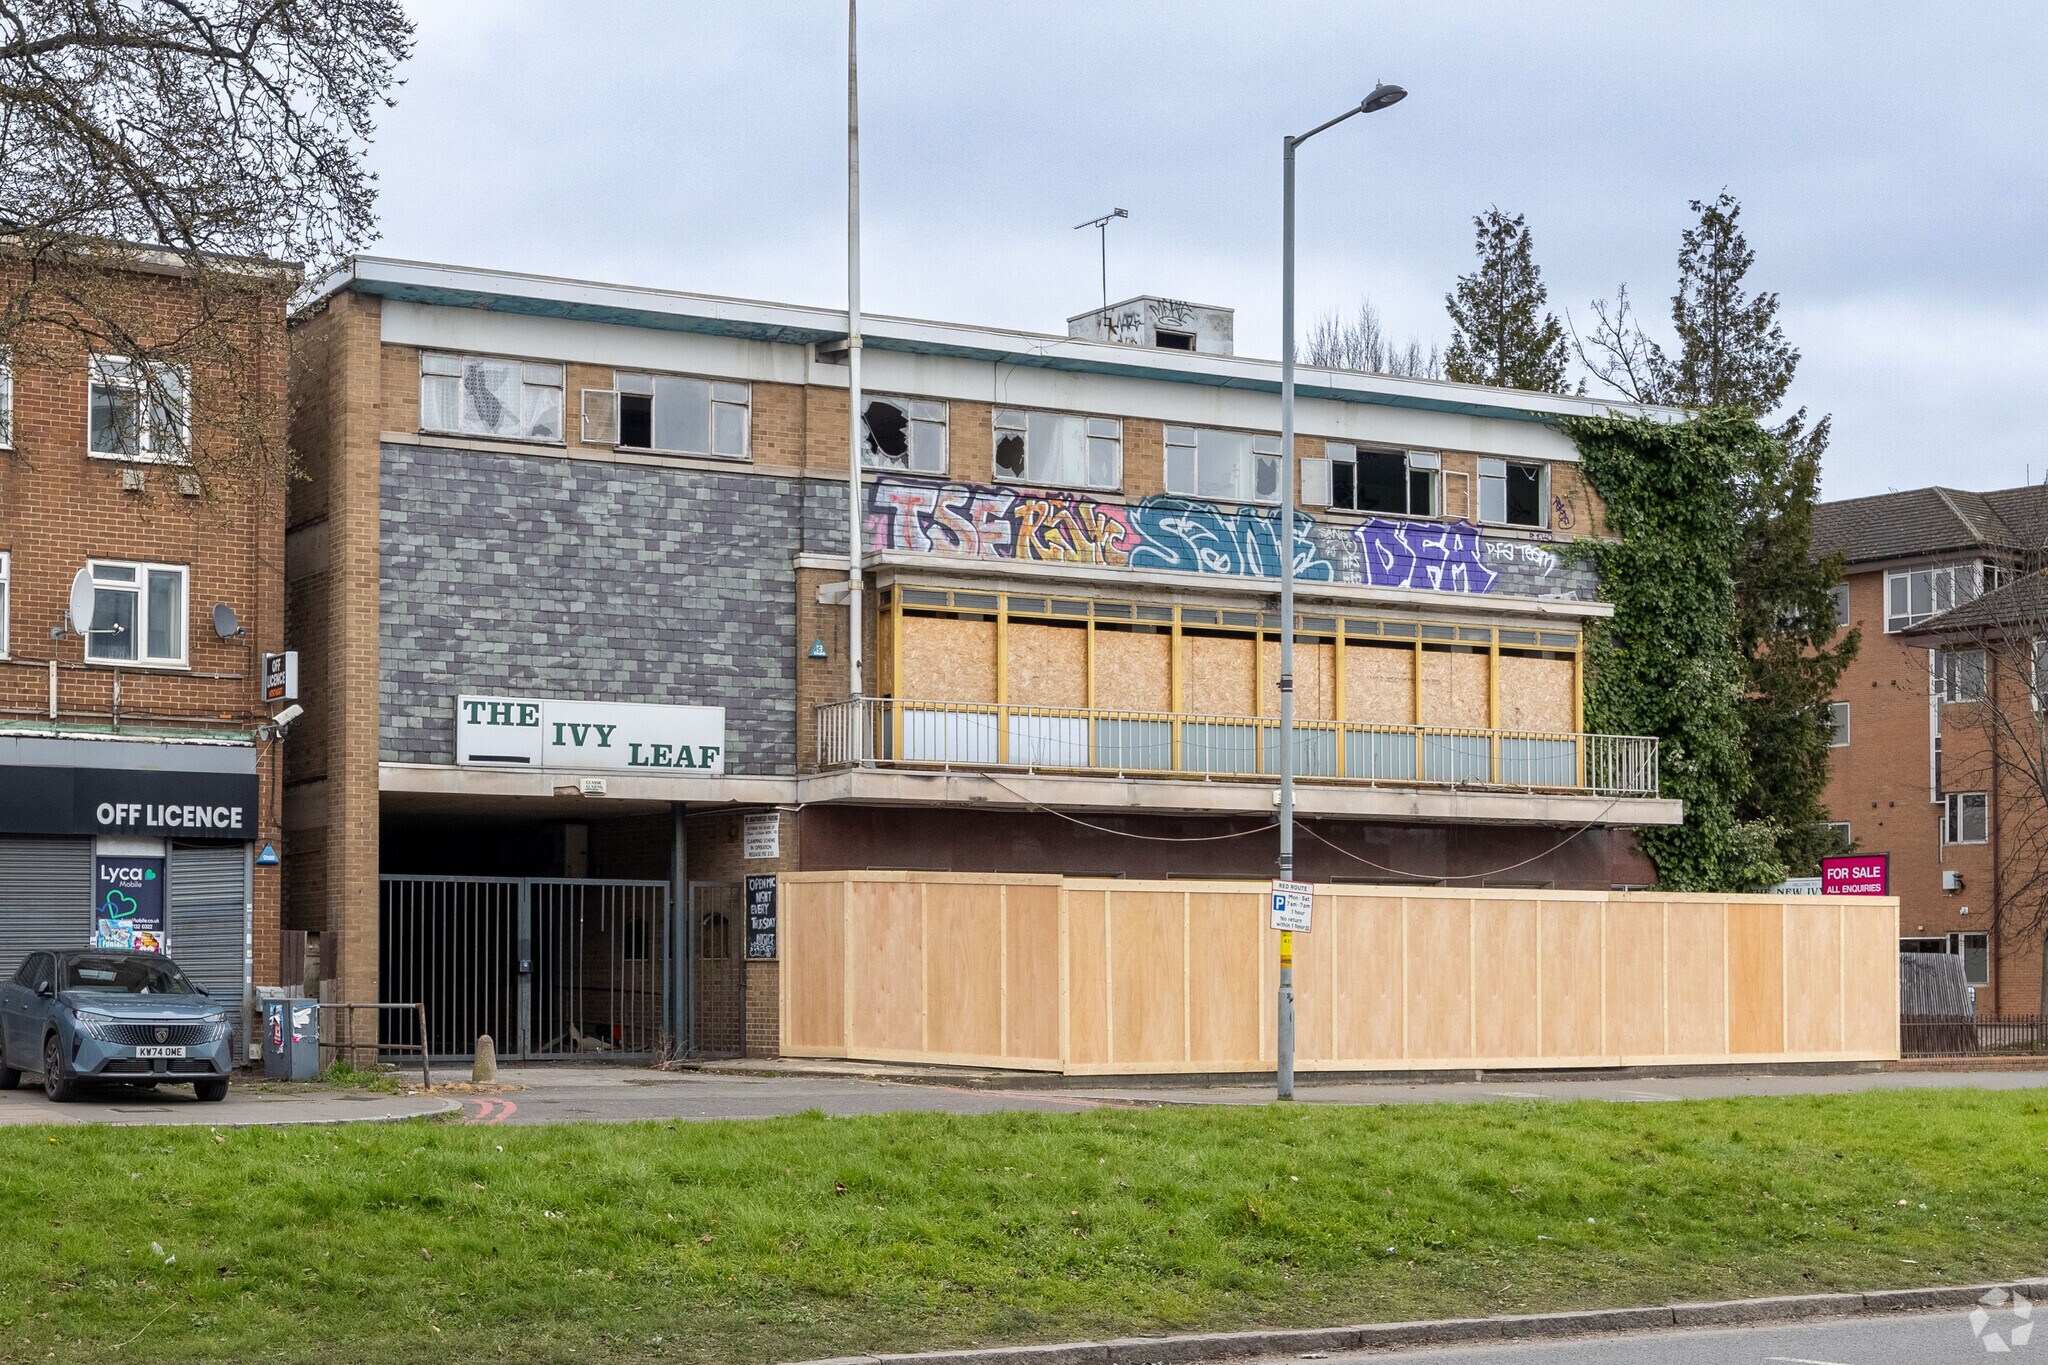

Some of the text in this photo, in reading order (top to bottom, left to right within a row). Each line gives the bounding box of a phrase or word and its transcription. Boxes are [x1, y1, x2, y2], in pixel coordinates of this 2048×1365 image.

[271, 658, 281, 673] OFF
[267, 671, 285, 688] LICENCE
[463, 701, 720, 769] THE IVY LEAF
[96, 802, 243, 829] OFF LICENCE
[101, 864, 142, 883] Lyca
[1827, 866, 1881, 880] FOR SALE
[749, 878, 766, 890] OPEN
[1827, 883, 1881, 894] ALL ENQUIRIES
[751, 904, 769, 915] EVERY
[1276, 897, 1284, 909] P
[140, 1048, 162, 1056] KW74
